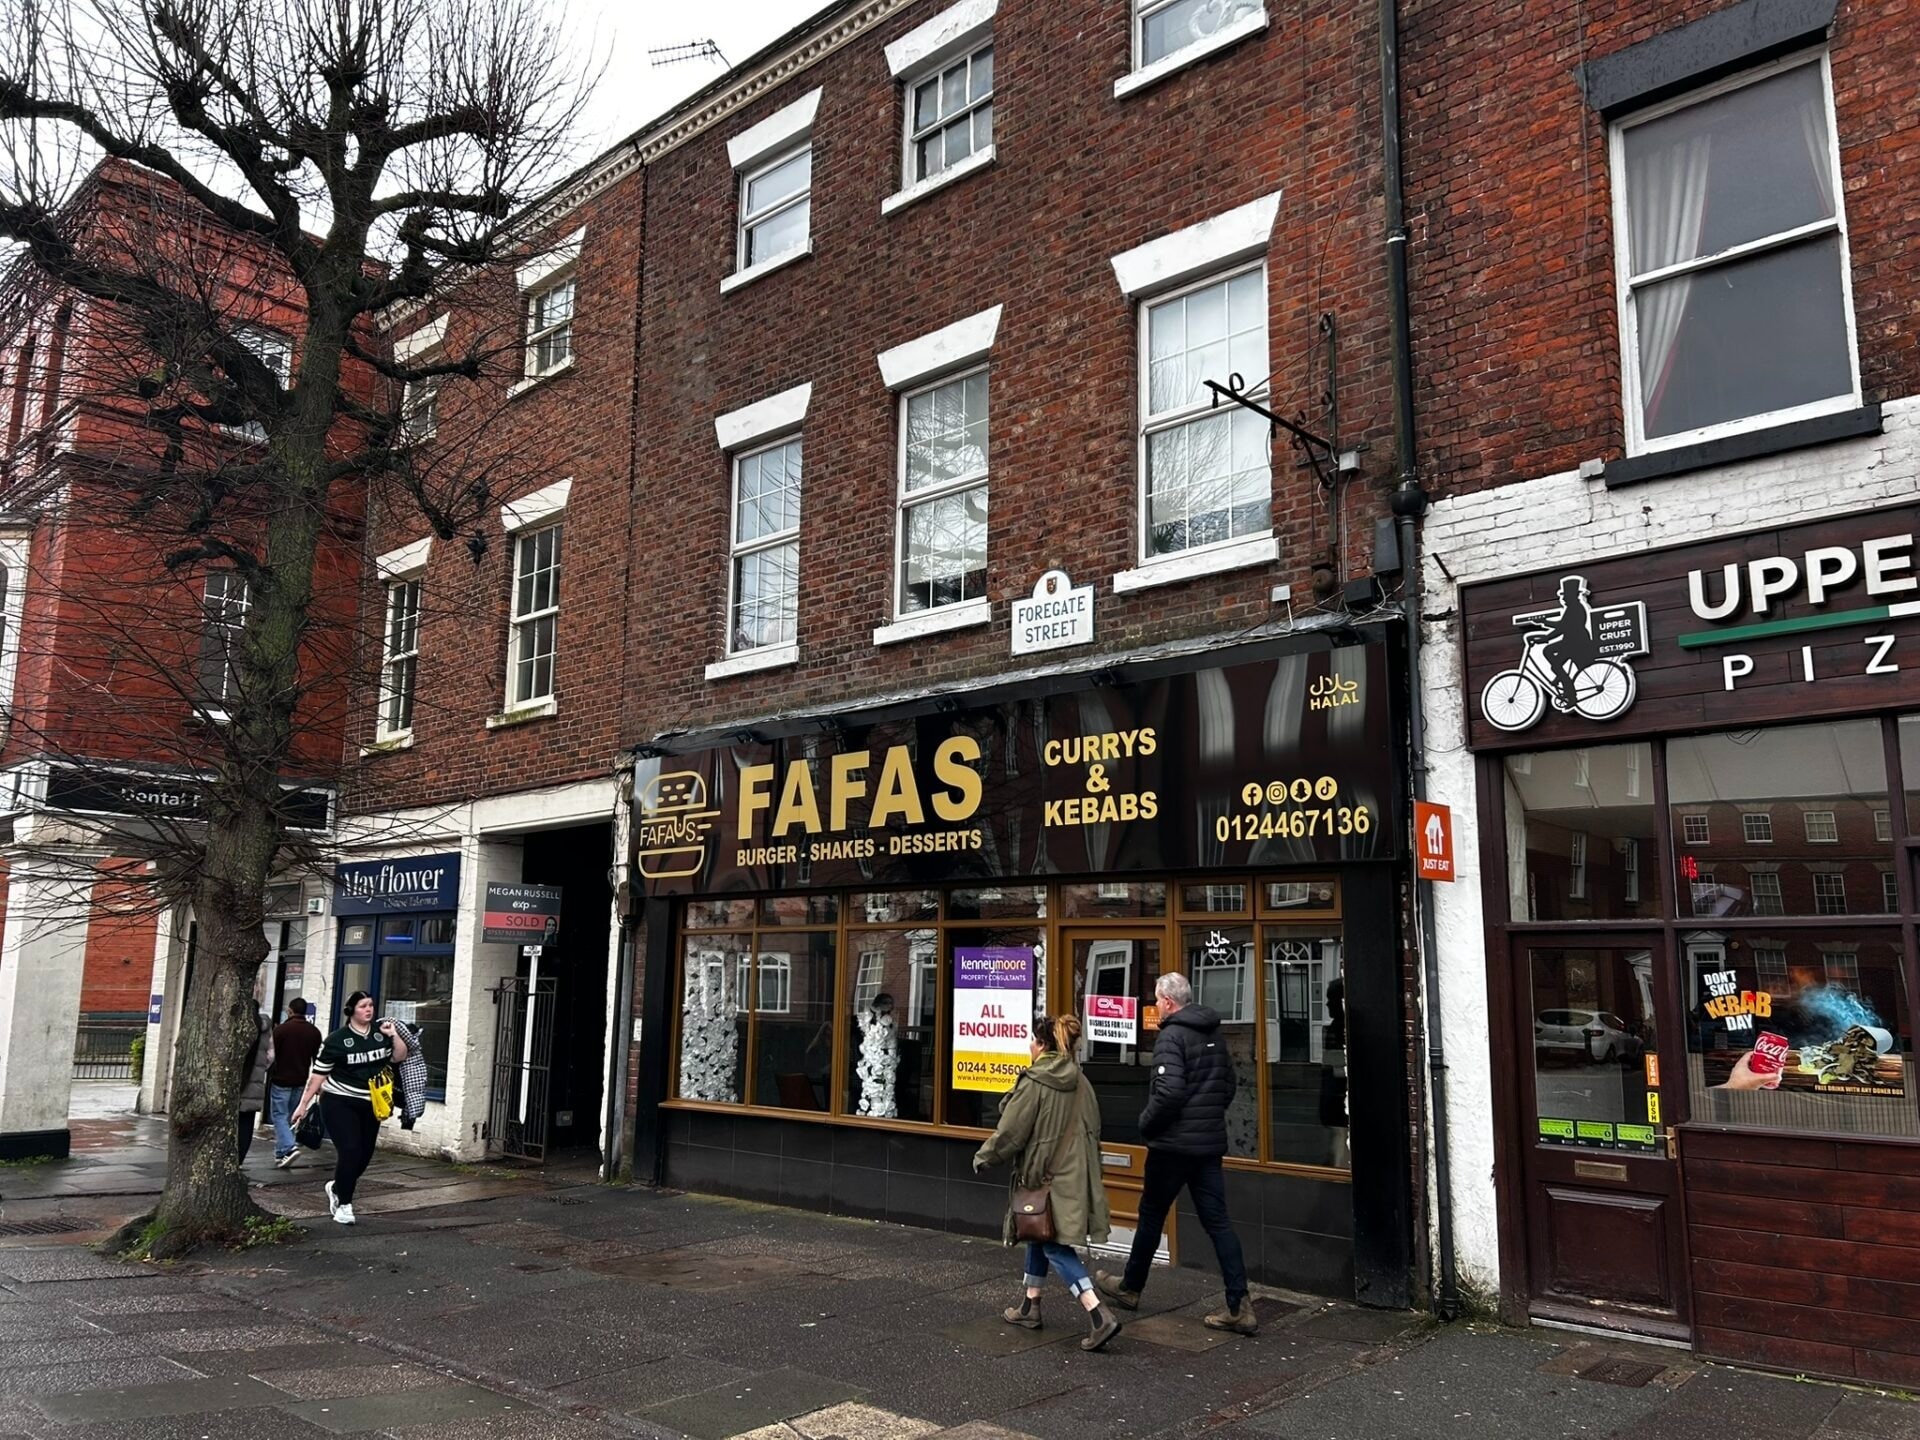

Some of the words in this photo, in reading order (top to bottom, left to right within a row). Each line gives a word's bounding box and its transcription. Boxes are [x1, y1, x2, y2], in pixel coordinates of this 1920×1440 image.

[1018, 595, 1086, 624] FOREGATE
[1025, 618, 1077, 643] STREET
[1598, 618, 1632, 631] UPPER
[1599, 628, 1633, 641] CRUST
[1309, 672, 1358, 696] حلال
[1310, 690, 1360, 711] HALAL
[1044, 727, 1157, 767] CURRYS
[1085, 763, 1111, 794] &
[736, 734, 983, 842] FAFAS
[1044, 790, 1158, 828] KEBABS
[1215, 805, 1370, 844] 0124467136
[736, 844, 797, 868] BURGER
[810, 837, 875, 863] SHAKES
[889, 828, 982, 856] DESSERTS
[1422, 857, 1438, 871] JUST
[1438, 859, 1450, 871] EAT
[341, 864, 445, 904] Mayflower
[488, 887, 522, 897] MEGAN
[523, 889, 560, 900] RUSSELL
[512, 900, 530, 911] exp
[505, 915, 540, 927] SOLD
[961, 955, 1026, 974] kenneymoore
[988, 974, 1026, 982] CONSULTANTS
[1703, 969, 1737, 986] DON'T
[1709, 982, 1737, 997] SKIP
[980, 1004, 1005, 1019] ALL
[1703, 990, 1772, 1020] KEBAB
[959, 1021, 1028, 1039] ENQUIRIES
[1110, 1020, 1120, 1029] FOR
[1725, 1013, 1753, 1031] DAY
[957, 1061, 987, 1073] 01244
[957, 1073, 1016, 1085] www.kenneymoore.c
